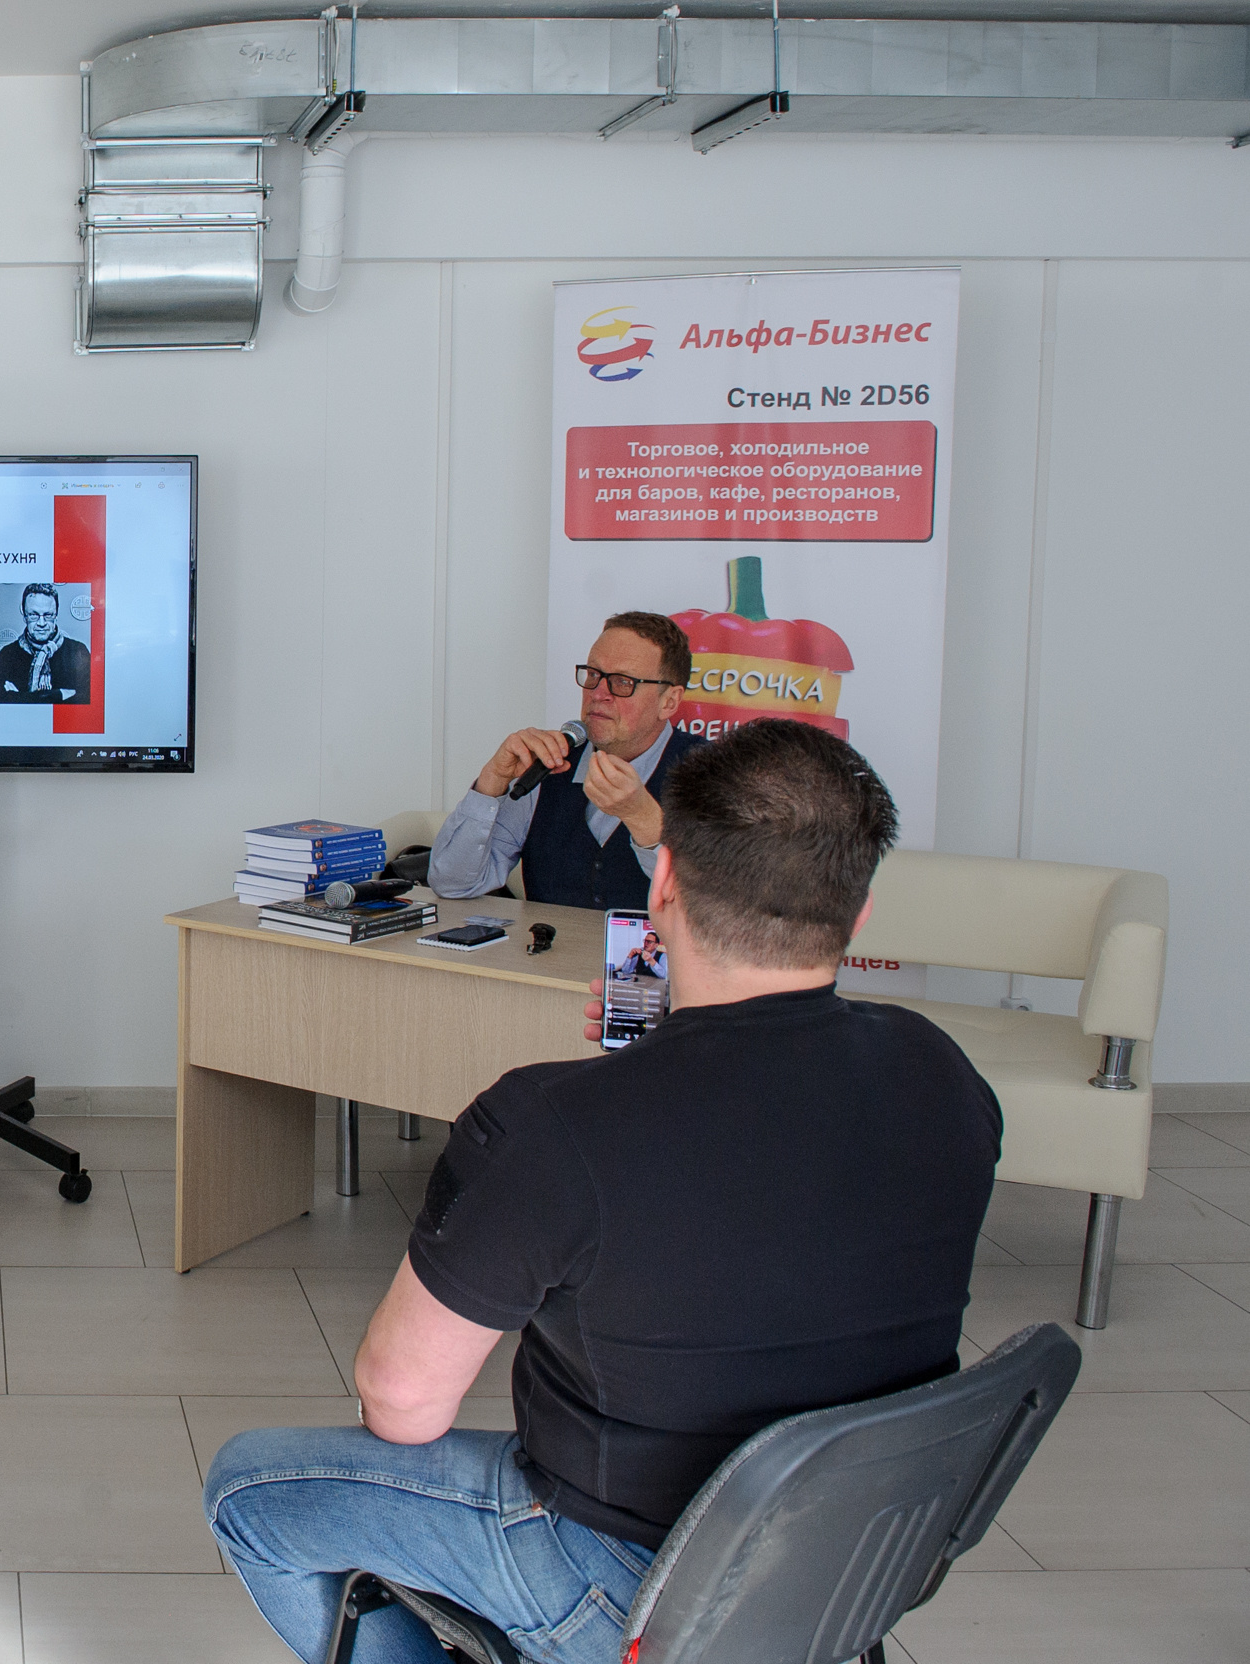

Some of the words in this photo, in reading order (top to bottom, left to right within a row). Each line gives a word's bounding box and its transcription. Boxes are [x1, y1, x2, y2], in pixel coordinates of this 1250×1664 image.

[680, 318, 932, 353] Альфа-Бизнес
[727, 387, 811, 410] Стенд
[821, 386, 851, 407] №
[860, 384, 930, 406] 2D56
[627, 441, 724, 461] Торговое,
[730, 440, 870, 460] холодильное
[578, 467, 590, 479] и
[596, 465, 764, 480] технологическое
[770, 461, 923, 482] оборудование
[595, 487, 632, 503] для
[637, 483, 703, 502] баров,
[709, 484, 765, 502] кафе,
[772, 486, 901, 504] ресторанов,
[615, 508, 719, 523] магазинов
[725, 508, 737, 521] и
[743, 507, 879, 524] производств
